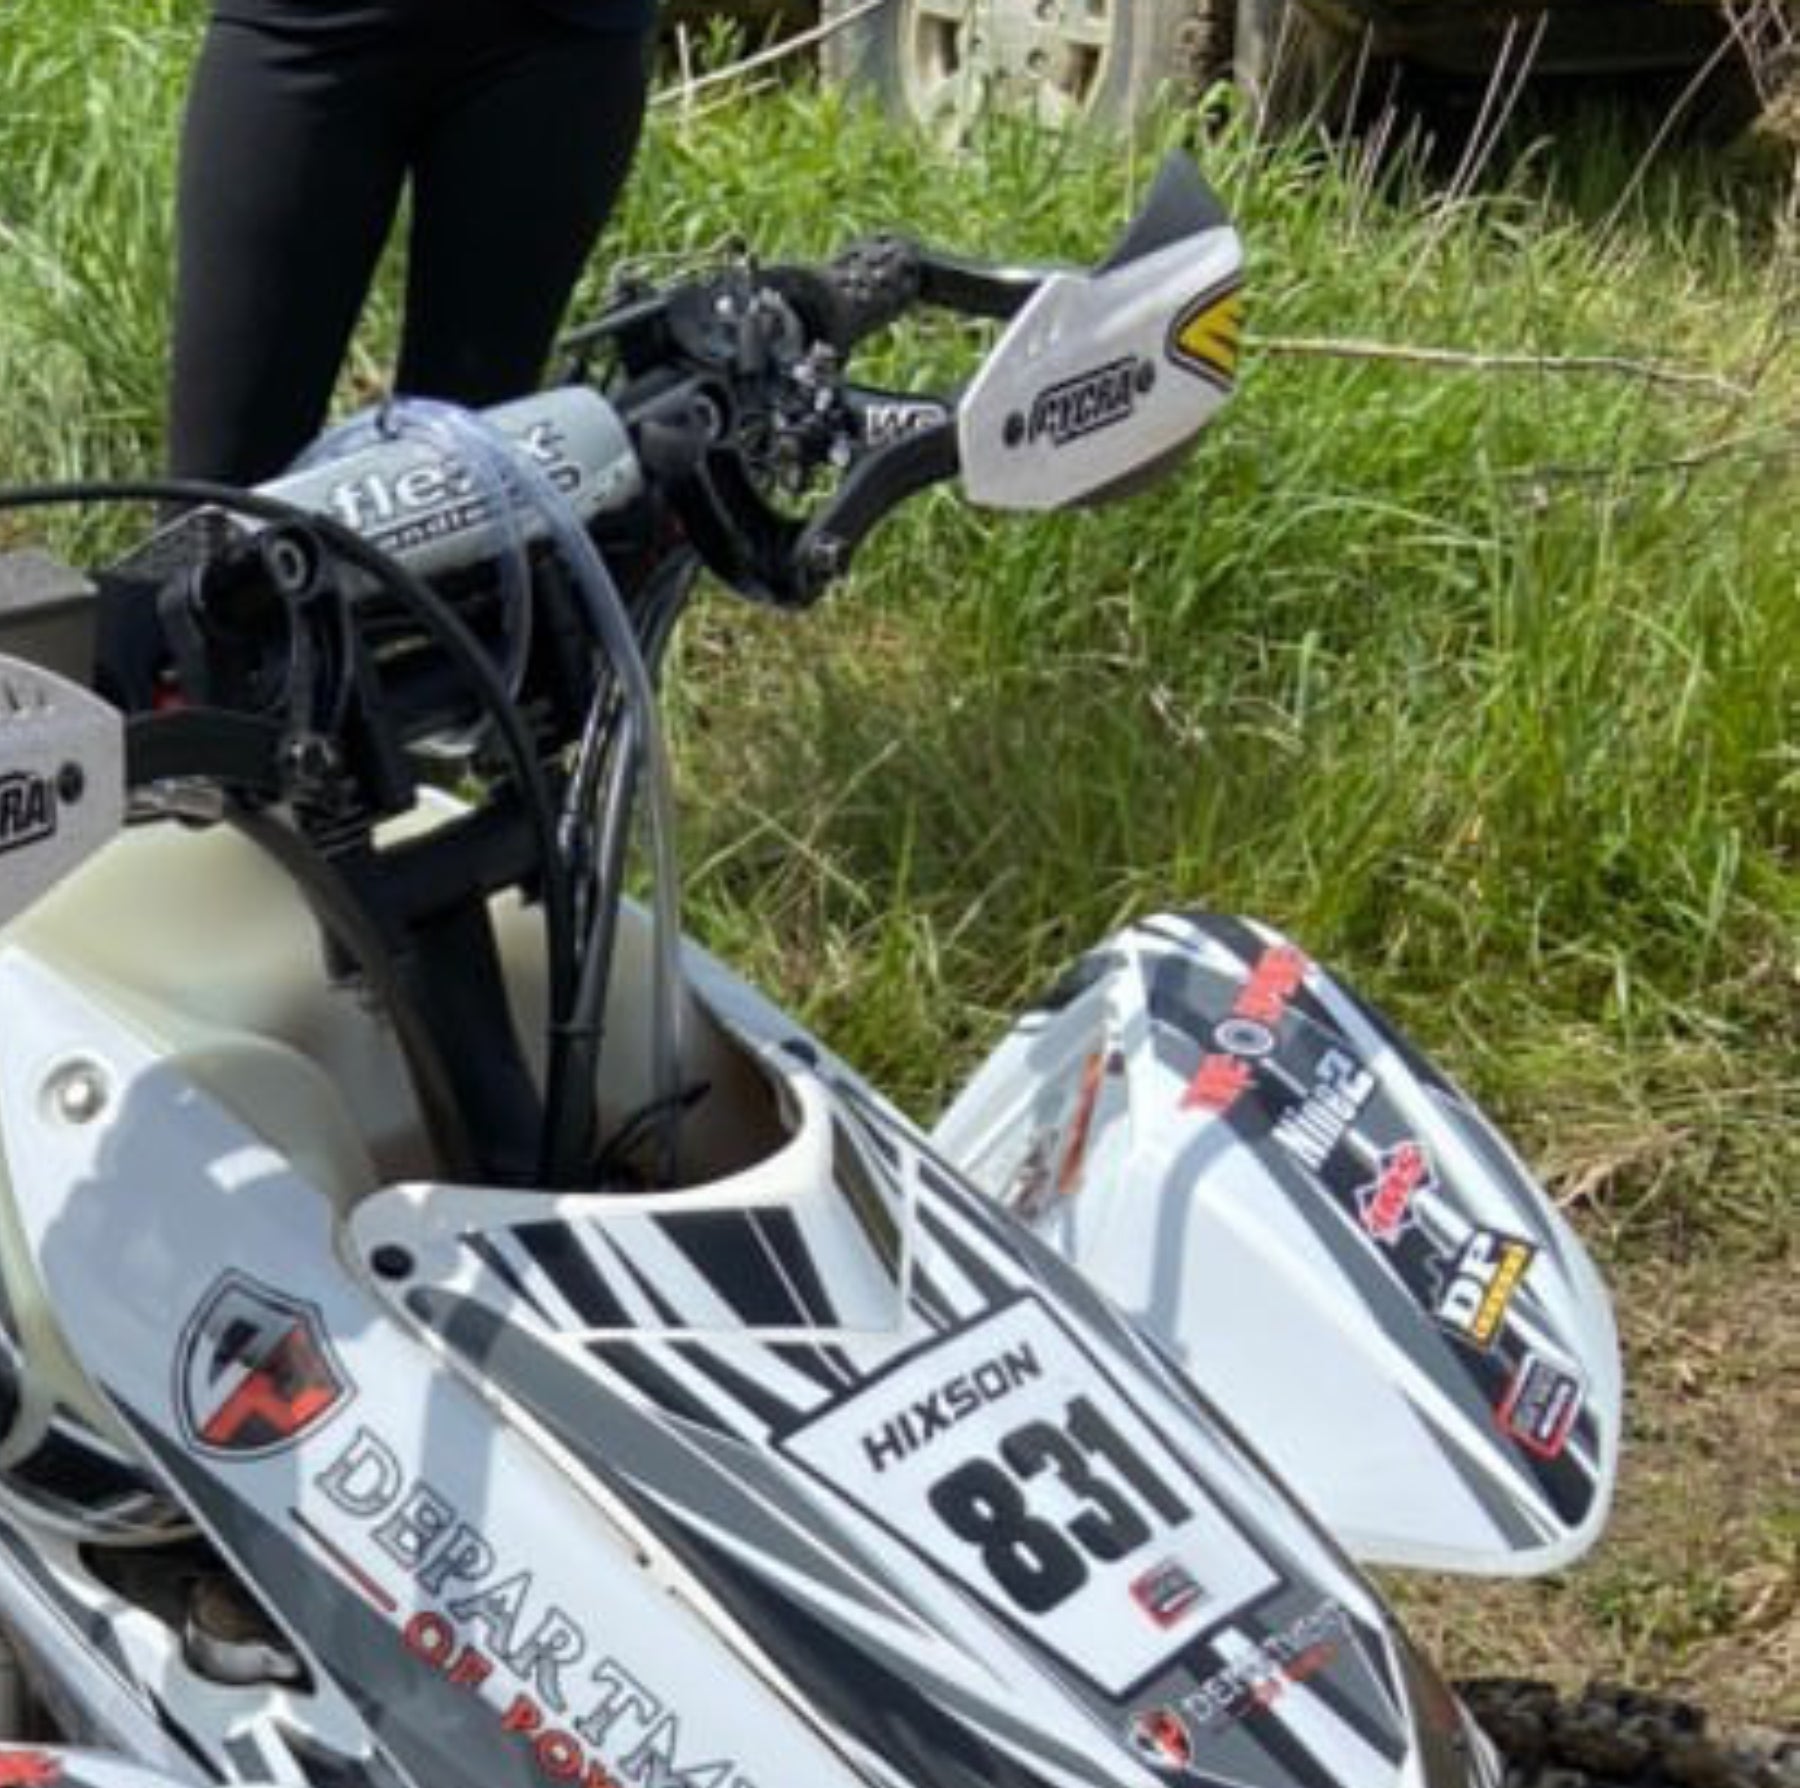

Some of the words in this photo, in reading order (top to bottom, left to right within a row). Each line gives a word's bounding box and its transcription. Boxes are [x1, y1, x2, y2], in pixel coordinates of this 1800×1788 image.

[860, 1340, 1043, 1472] HIXSON
[927, 1392, 1194, 1617] 831
[403, 1610, 494, 1692] OF
